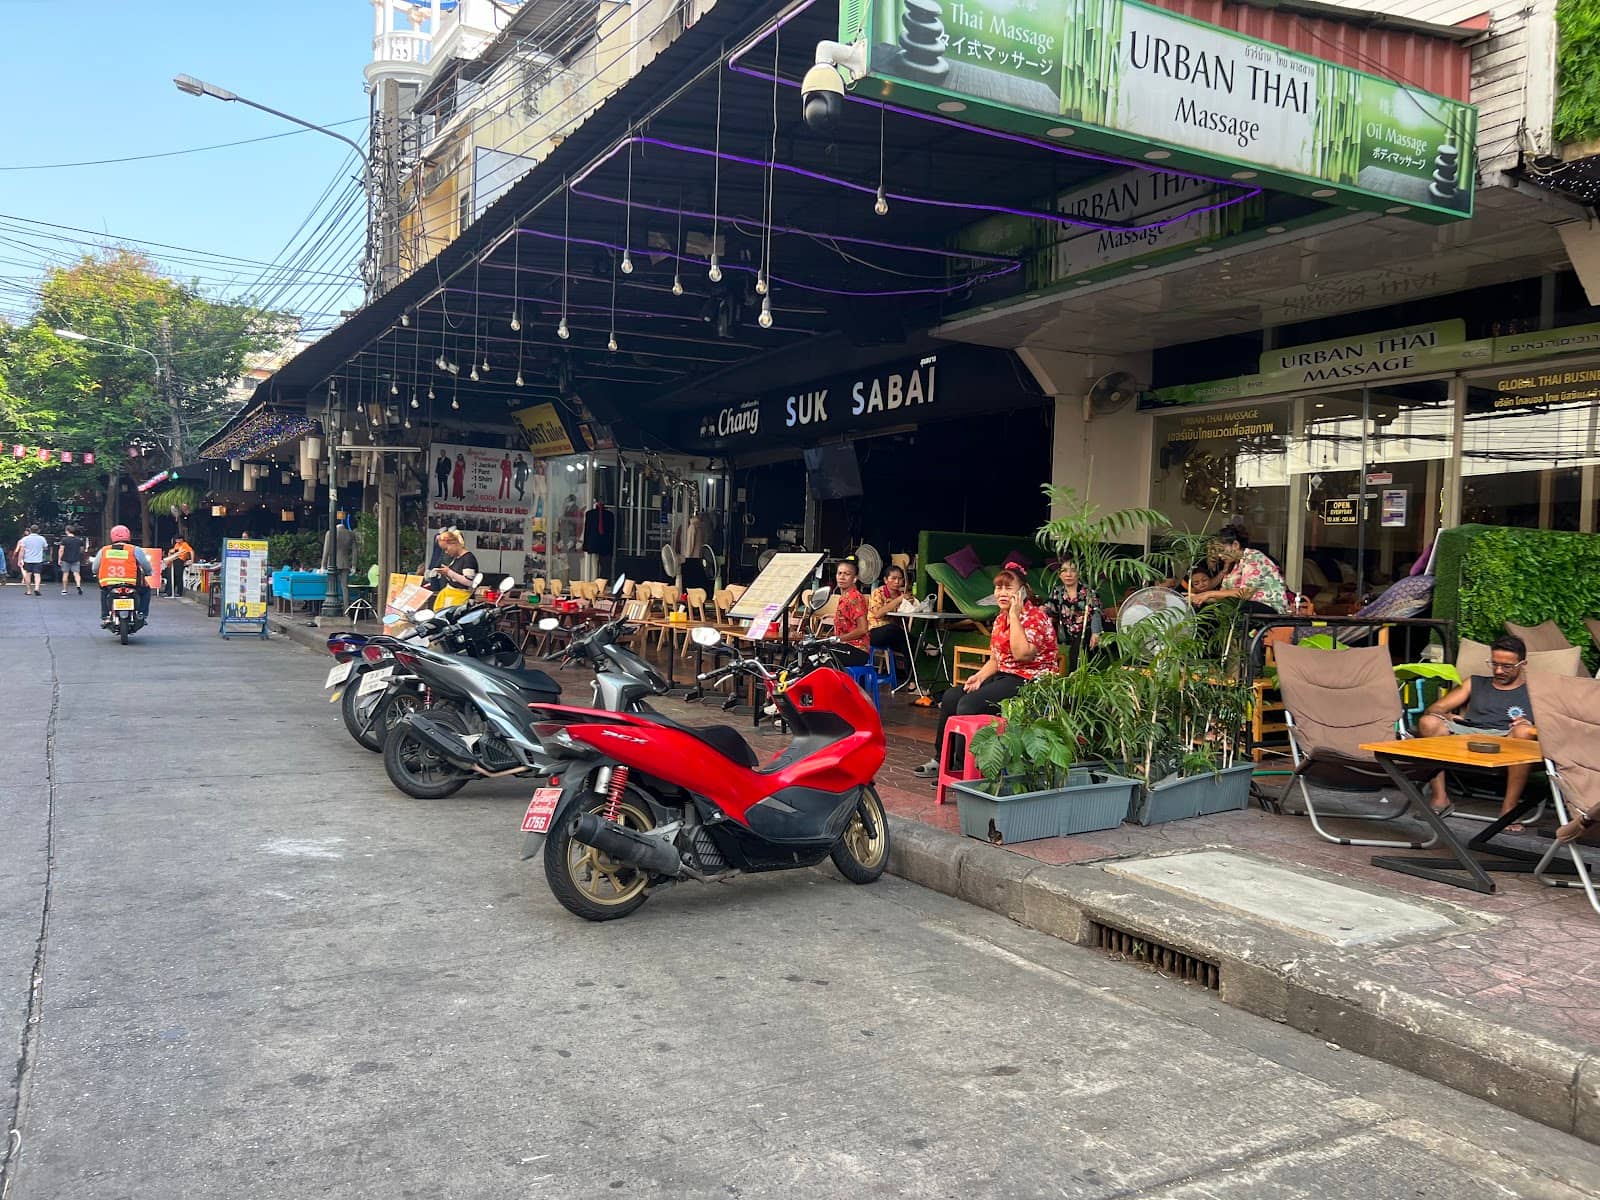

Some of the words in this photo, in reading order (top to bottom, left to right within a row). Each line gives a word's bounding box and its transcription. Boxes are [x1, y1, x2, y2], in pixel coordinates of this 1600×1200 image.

[951, 3, 983, 31] Thai
[989, 15, 1055, 55] Massage
[936, 33, 1054, 76] タイ式マッサージ
[1129, 30, 1235, 95] URBAN
[1247, 65, 1309, 115] THAI
[1174, 96, 1260, 148] Massage
[1366, 122, 1383, 140] Oil
[1385, 127, 1428, 156] Massage
[1281, 343, 1364, 370] URBAN
[1375, 331, 1436, 354] THAI
[1302, 355, 1416, 383] MASSAGE
[1497, 377, 1537, 391] GLOBAL
[1538, 374, 1562, 387] THAI
[1564, 369, 1600, 384] BUSINE
[785, 389, 828, 427] SUK
[852, 366, 936, 416] SABAI
[718, 407, 760, 437] Chang
[1224, 409, 1259, 422] MASSAGE
[228, 542, 250, 550] BOSS
[107, 565, 126, 578] 33
